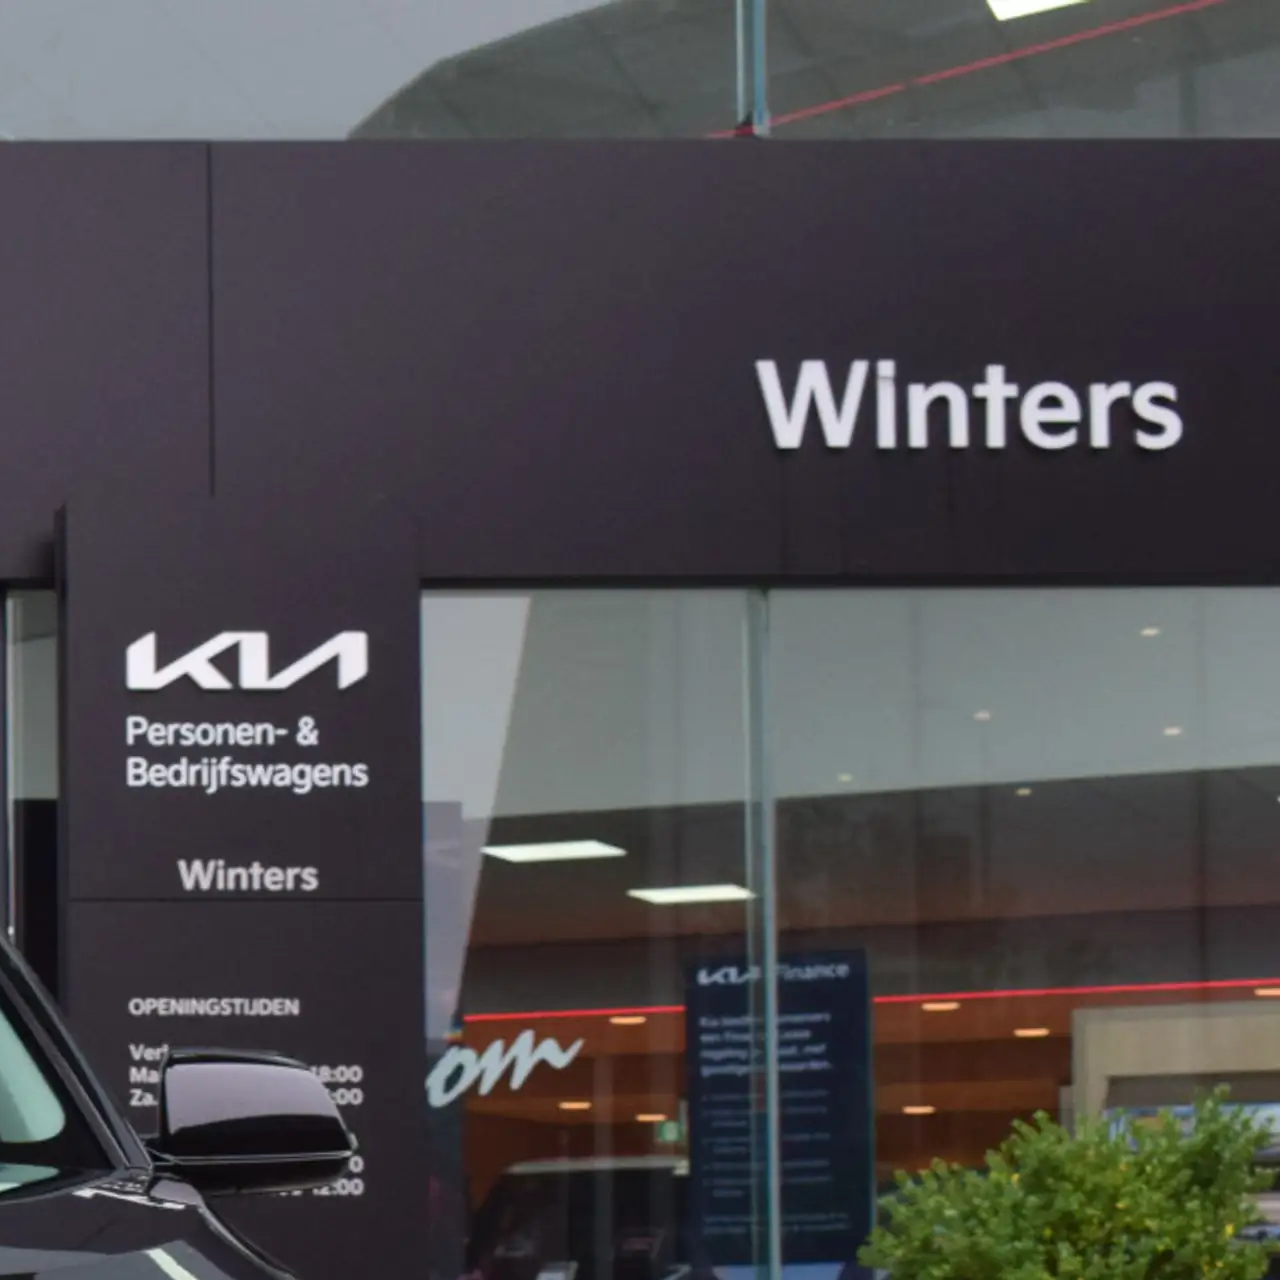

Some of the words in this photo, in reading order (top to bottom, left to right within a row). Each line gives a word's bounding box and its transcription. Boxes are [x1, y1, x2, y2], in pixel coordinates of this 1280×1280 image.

[755, 359, 1184, 450] Winters
[126, 631, 368, 690] KIA
[126, 716, 288, 746] Personen-
[296, 716, 319, 746] &
[126, 756, 369, 795] Bedrijfswagens
[177, 859, 319, 891] Winters
[127, 998, 301, 1016] OPENINGSTIJDEN
